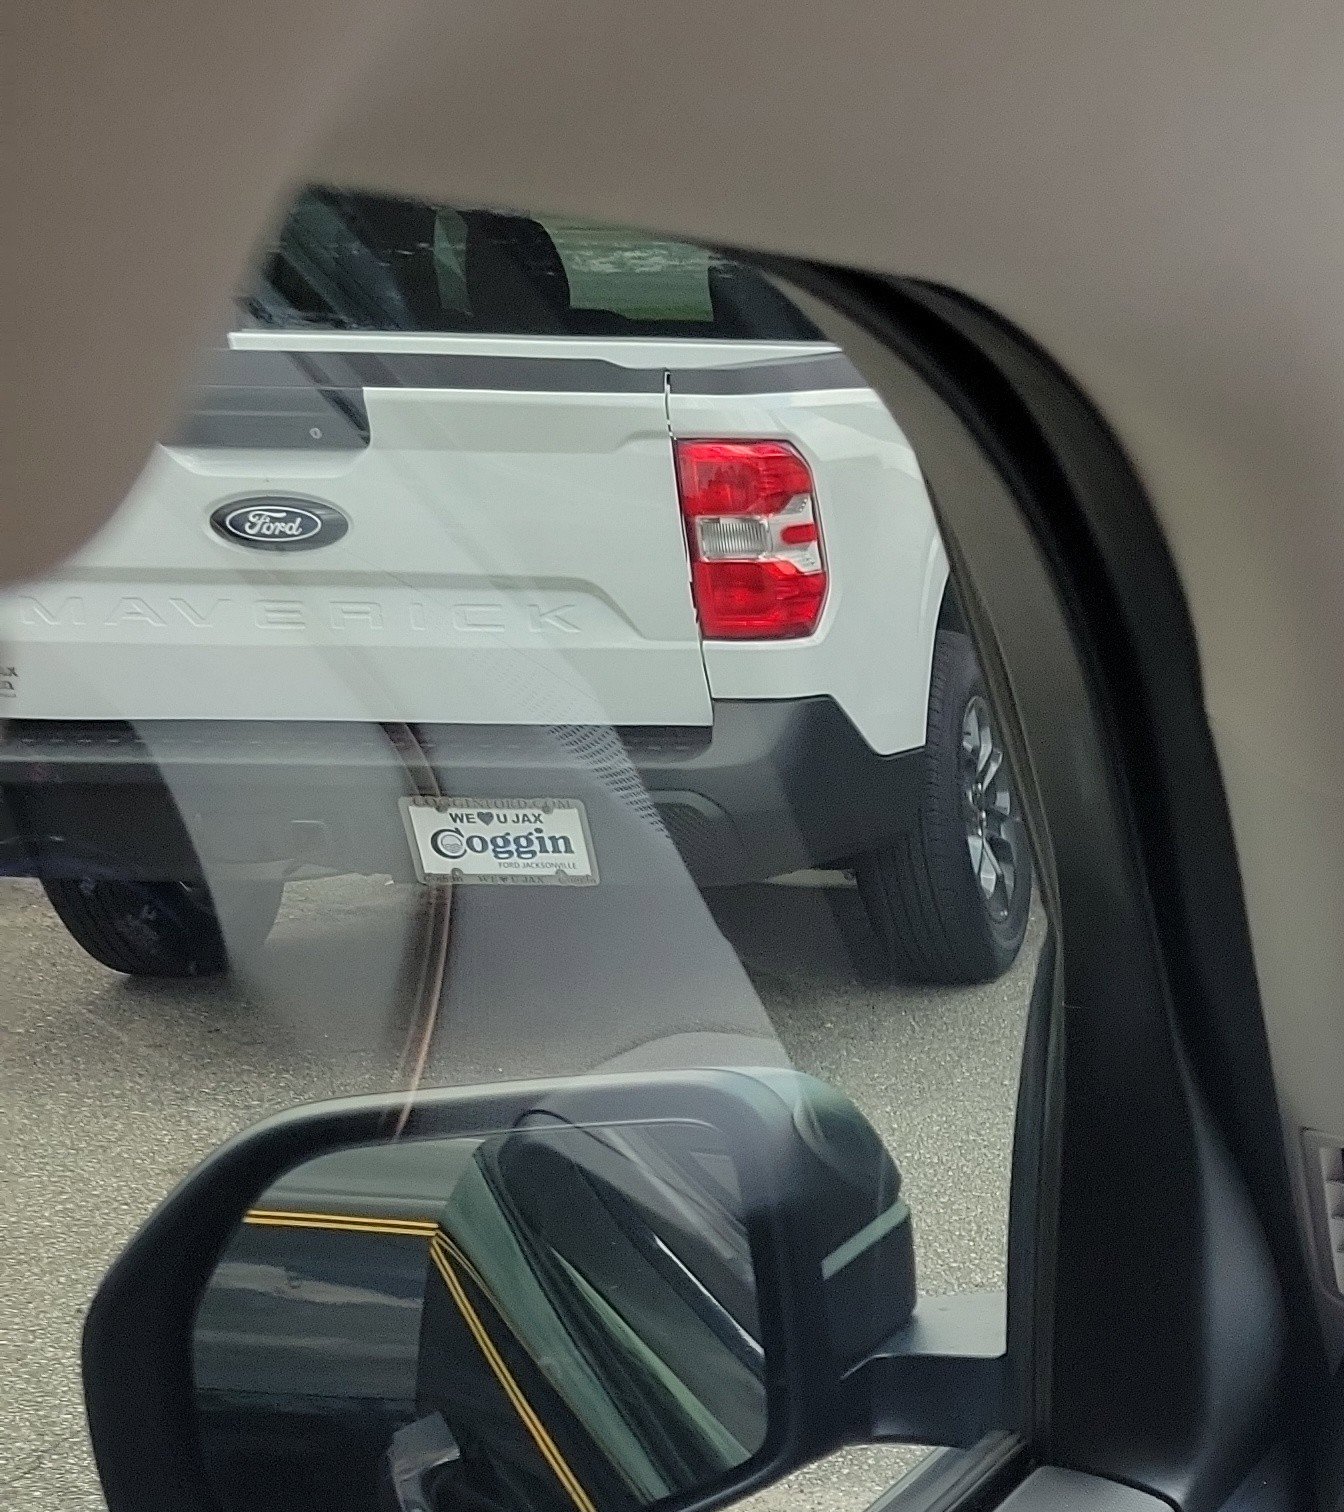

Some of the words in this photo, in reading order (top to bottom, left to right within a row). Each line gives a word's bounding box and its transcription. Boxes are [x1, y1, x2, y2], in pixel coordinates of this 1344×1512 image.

[245, 510, 303, 536] Ford
[19, 597, 581, 633] MAVERICK
[448, 812, 477, 824] WE
[496, 812, 508, 824] U
[511, 813, 544, 824] JAX
[430, 827, 575, 860] Coggin
